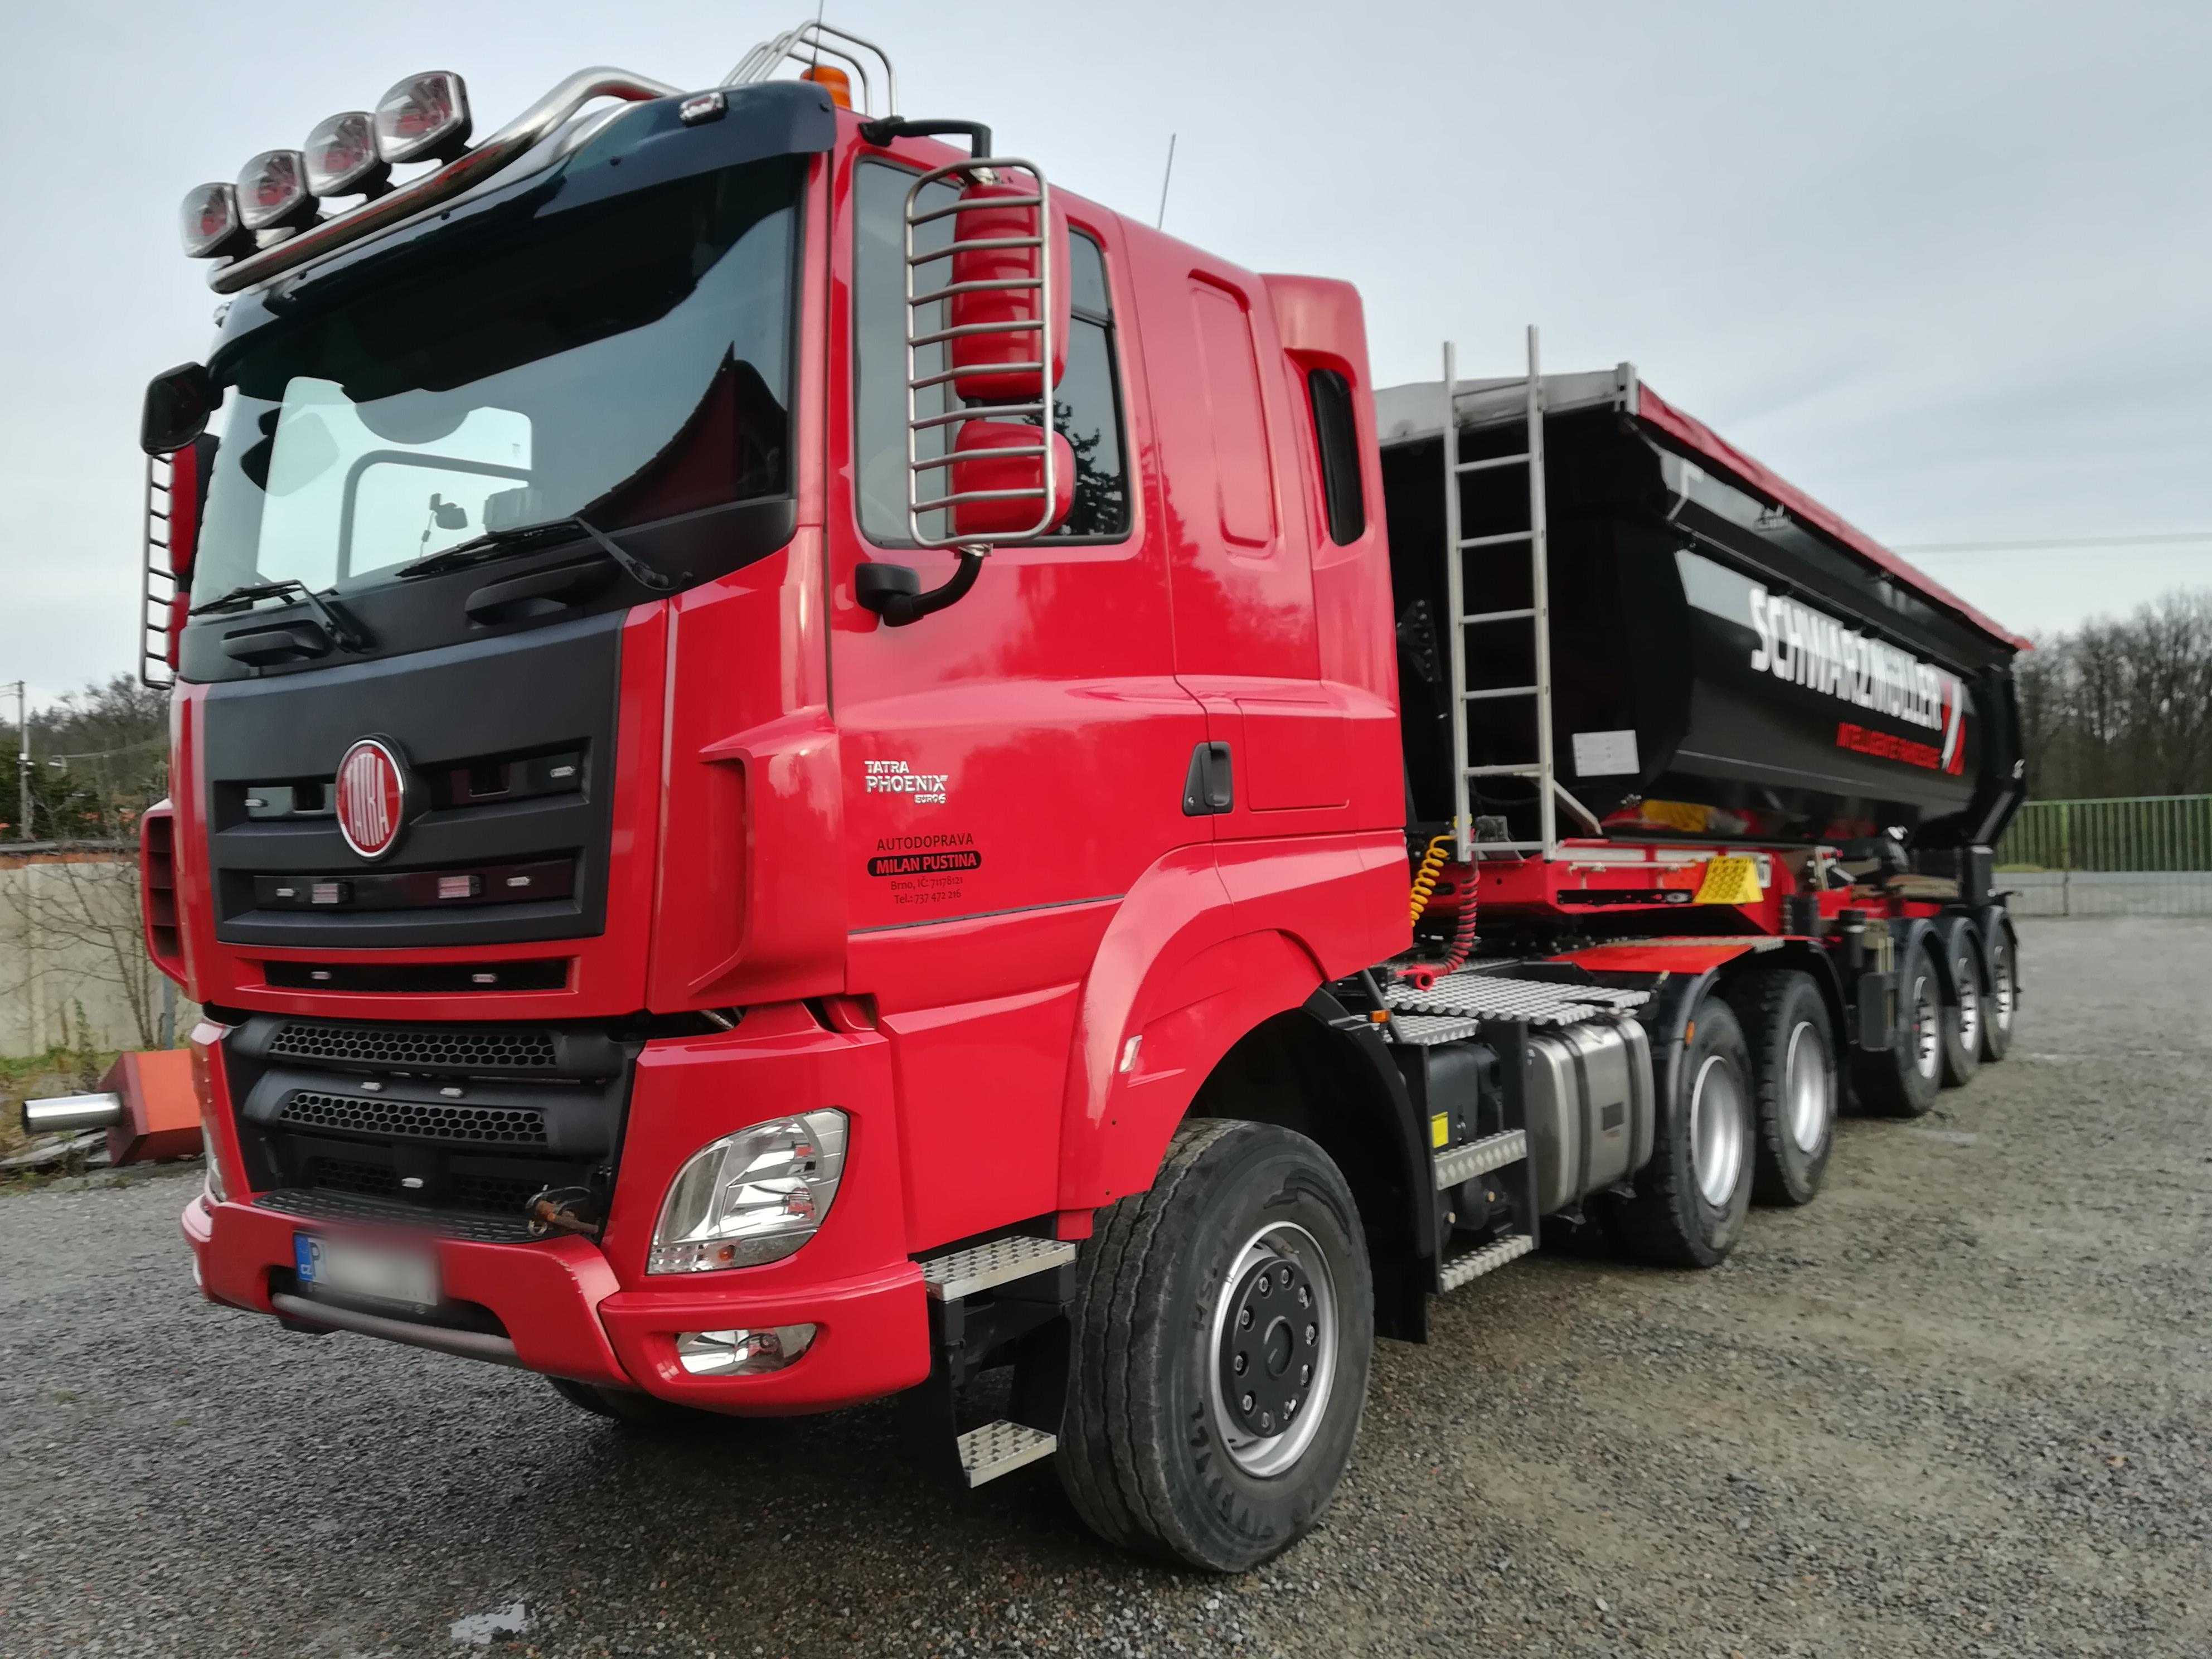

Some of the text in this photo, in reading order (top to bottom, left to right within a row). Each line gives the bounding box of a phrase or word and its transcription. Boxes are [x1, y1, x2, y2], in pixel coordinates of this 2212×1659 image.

[864, 760, 910, 774] TATRA
[865, 775, 949, 793] PHOENIX
[876, 833, 974, 852] AUTODOPRAVA
[876, 852, 977, 874] MILAN PUSTINA
[891, 881, 915, 890] Brno,
[930, 876, 963, 889] 71178121
[915, 894, 929, 904] 737
[931, 892, 946, 903] 472
[948, 889, 962, 899] 216
